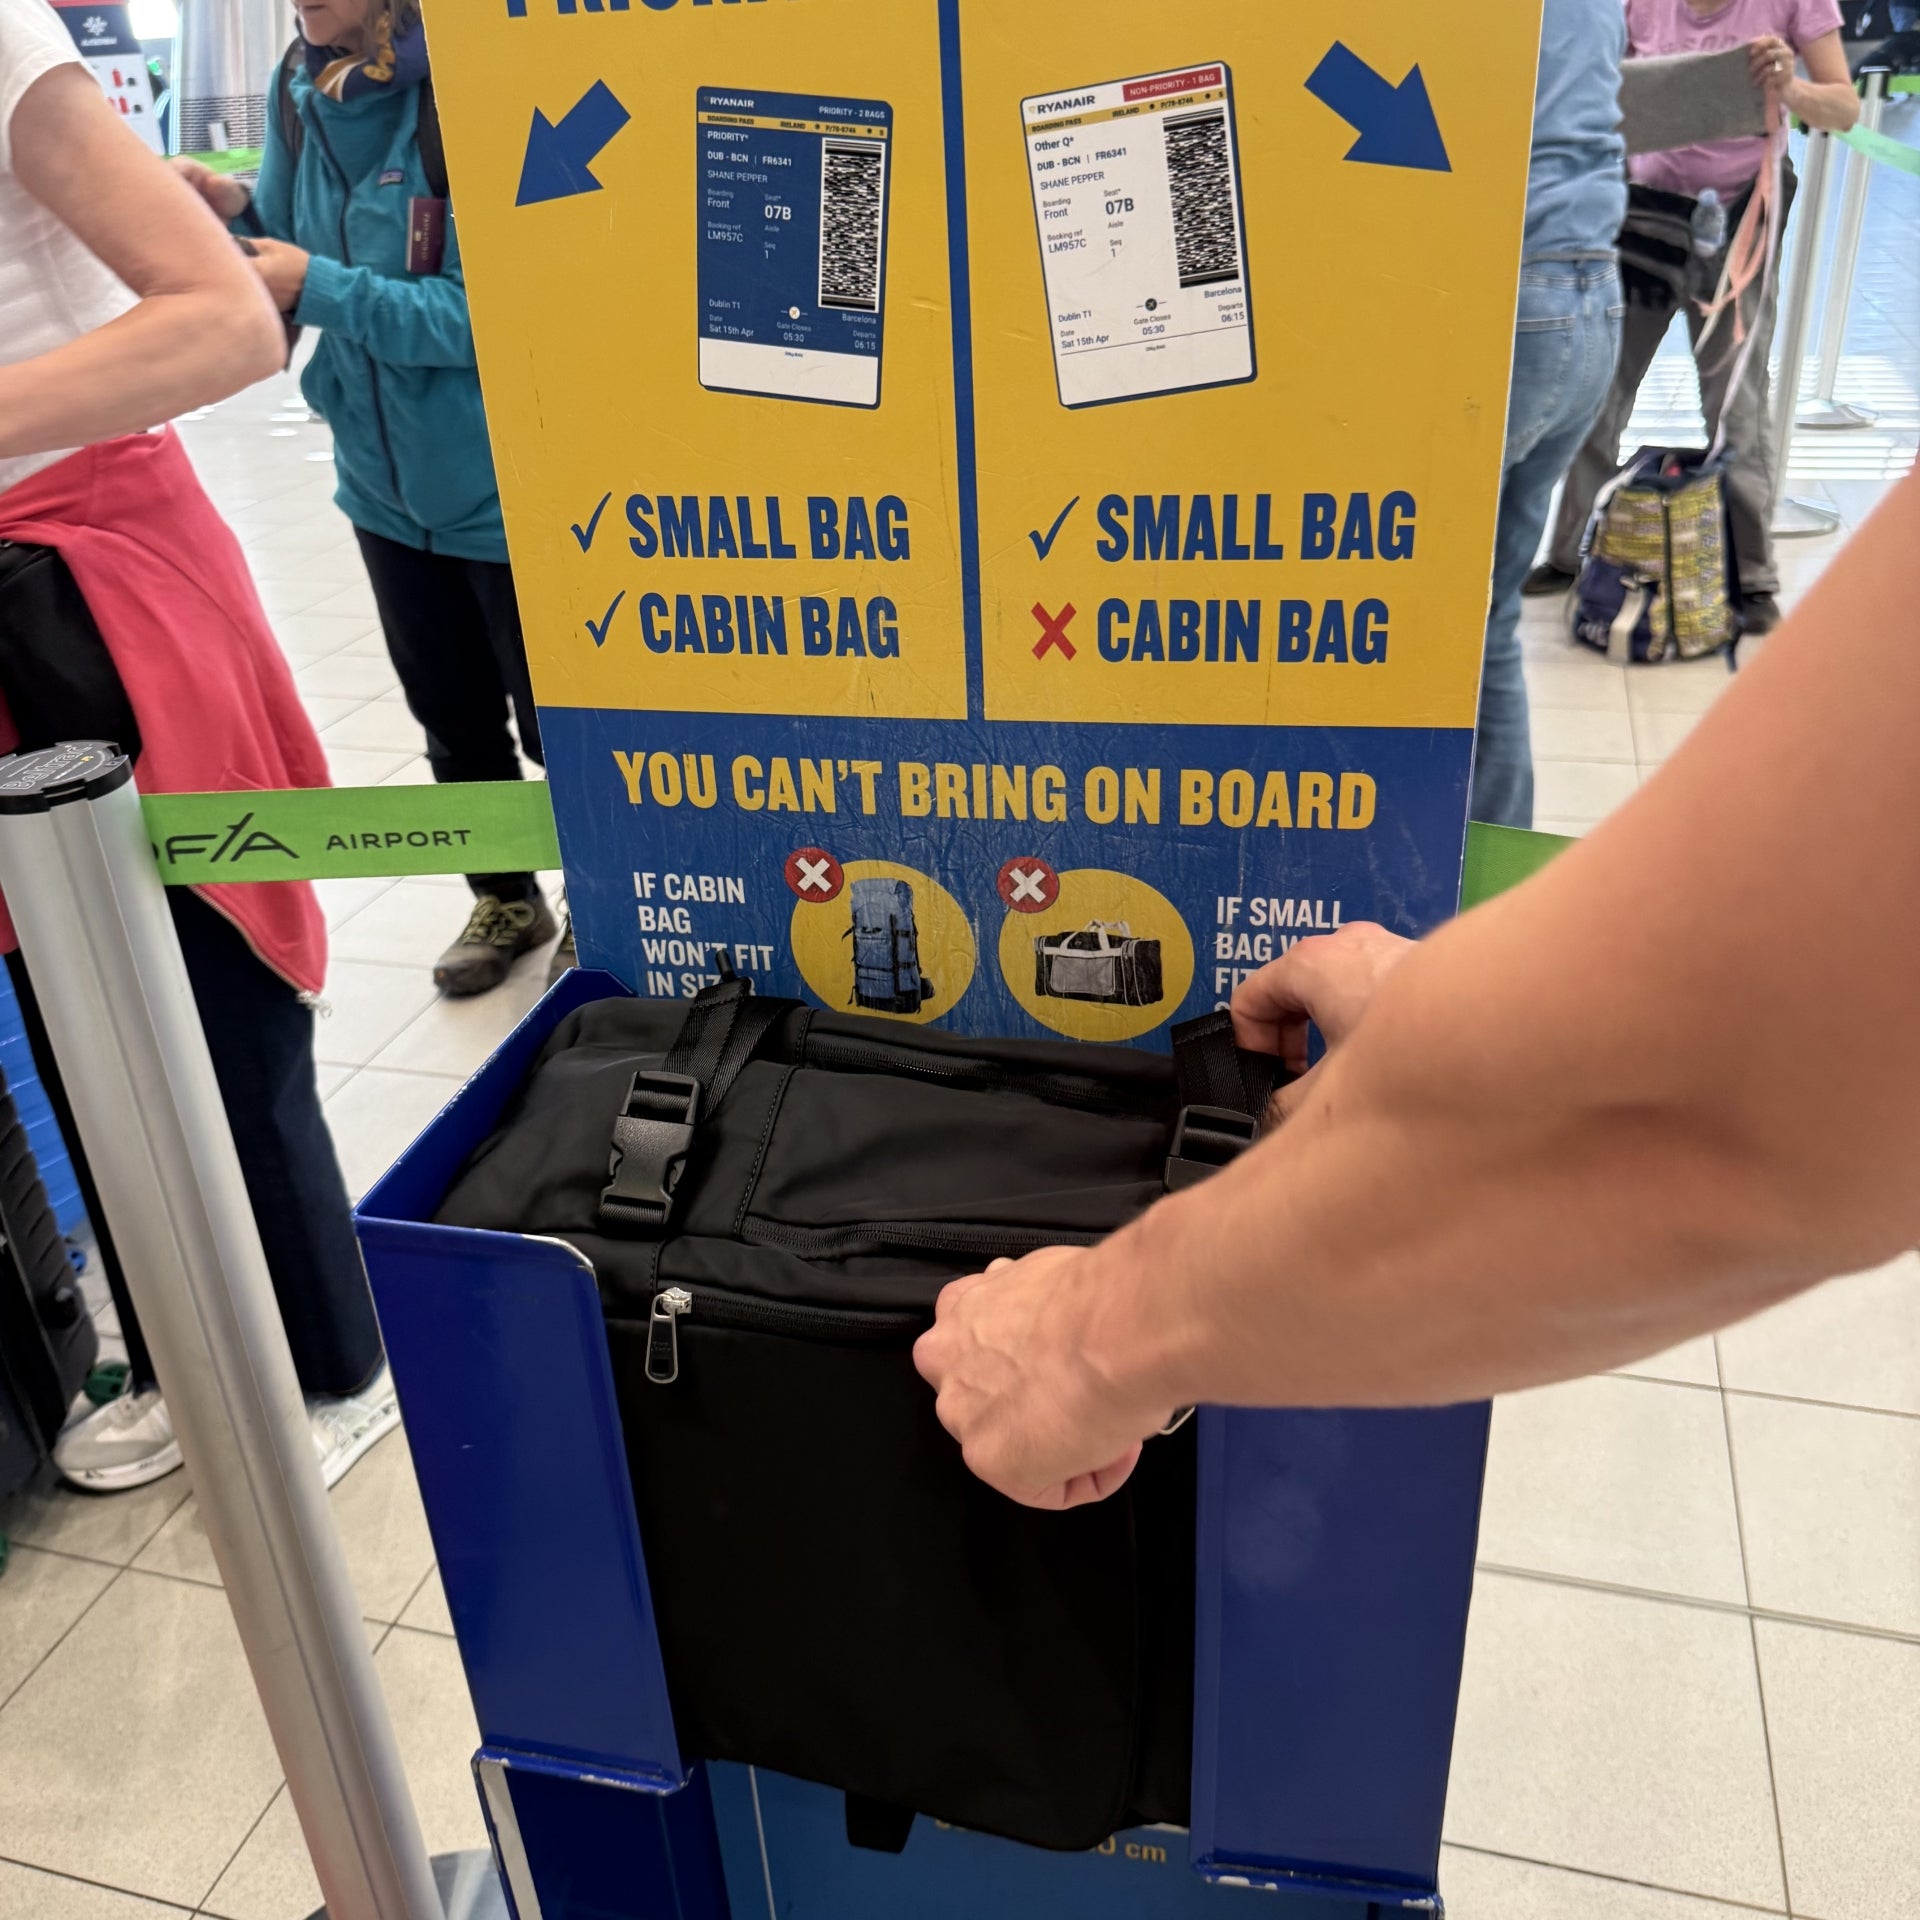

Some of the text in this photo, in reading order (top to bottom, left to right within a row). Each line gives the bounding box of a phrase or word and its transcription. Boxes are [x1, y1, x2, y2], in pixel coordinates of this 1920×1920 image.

[1129, 79, 1185, 96] NON-PRIORITY
[1192, 76, 1197, 86] 1
[1198, 73, 1215, 84] BAG
[710, 97, 755, 109] RYANAIR
[1037, 95, 1096, 114] RYANAIR
[707, 115, 738, 125] BOARDING
[819, 105, 853, 117] PRIORITY
[859, 109, 864, 118] 2
[865, 109, 885, 119] BAGS
[1032, 120, 1064, 133] BOARDING
[1034, 139, 1061, 152] Other
[707, 150, 724, 161] DUB
[731, 152, 749, 163] BCN
[762, 155, 792, 167] FR6341
[1037, 160, 1055, 171] DUB
[1062, 156, 1081, 167] BCN
[1096, 147, 1127, 161] FR6341
[707, 170, 768, 183] SHANE PEPPER
[1040, 171, 1105, 190] SHANE PEPPER
[707, 197, 730, 208] Front
[1105, 198, 1134, 215] 07B
[764, 204, 792, 220] 07B
[1044, 207, 1068, 220] Front
[1107, 219, 1124, 229] Aisle
[707, 230, 743, 243] LM957C
[1048, 237, 1087, 254] LM957C
[1111, 249, 1116, 258] 1
[764, 250, 769, 259] 1
[1204, 286, 1242, 299] Barcelona
[709, 298, 741, 310] Dublin T1
[842, 313, 877, 325] Barcelona
[1058, 310, 1092, 323] Dublin T1
[1221, 312, 1245, 323] 06:15
[709, 324, 754, 338] Sat 15th Apr
[783, 332, 805, 343] 05:30
[1061, 334, 1110, 349] Sat 15th Apr
[625, 494, 910, 561] SMALL BAG
[1096, 490, 1417, 562] SMALL BAG
[639, 592, 900, 659] CABIN BAG
[1097, 598, 1389, 664] CABIN BAG
[612, 750, 1377, 830] YOU CAN'T BRING ON BOARD
[152, 812, 472, 865] FIA AIRPORT
[633, 872, 746, 904] IF CABIN
[638, 905, 692, 934] BAG
[1217, 896, 1346, 929] IF SMALL
[1216, 932, 1273, 961] BAG
[734, 943, 774, 971] FIT
[647, 970, 675, 997] IN
[1125, 1839, 1166, 1863] cm
